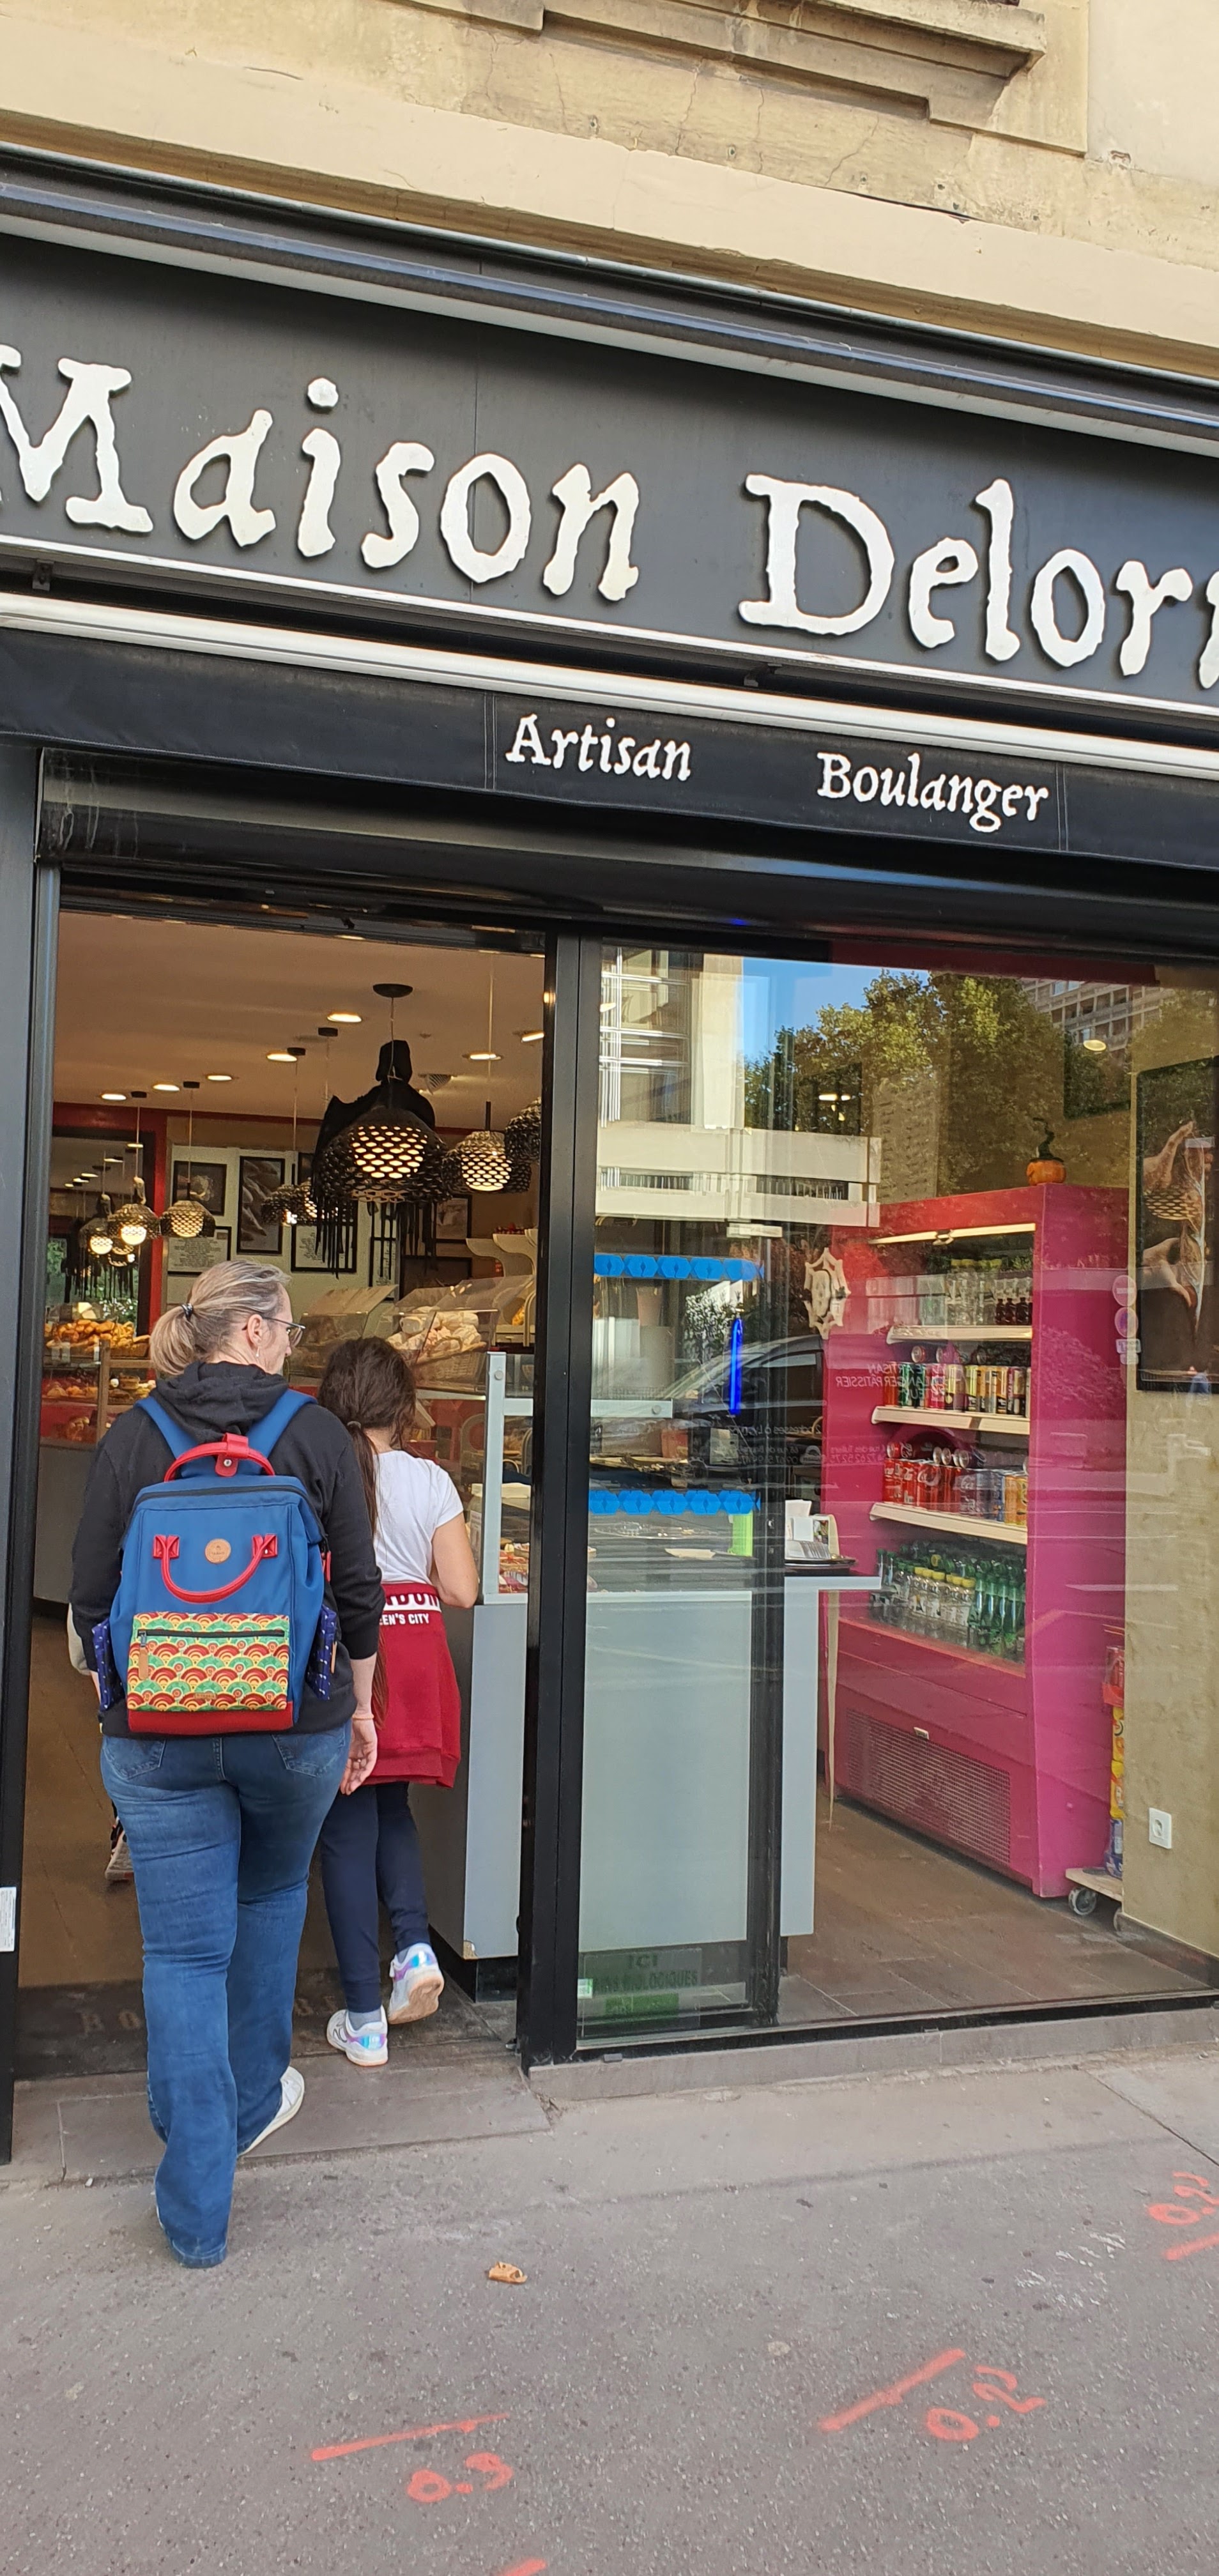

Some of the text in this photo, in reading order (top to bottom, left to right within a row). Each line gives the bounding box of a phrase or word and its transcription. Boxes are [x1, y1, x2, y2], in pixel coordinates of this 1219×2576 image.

[0, 344, 1219, 689] Maison Delor
[505, 714, 1049, 832] Artisan Boulanger
[379, 1613, 430, 1625] EN'S CITY
